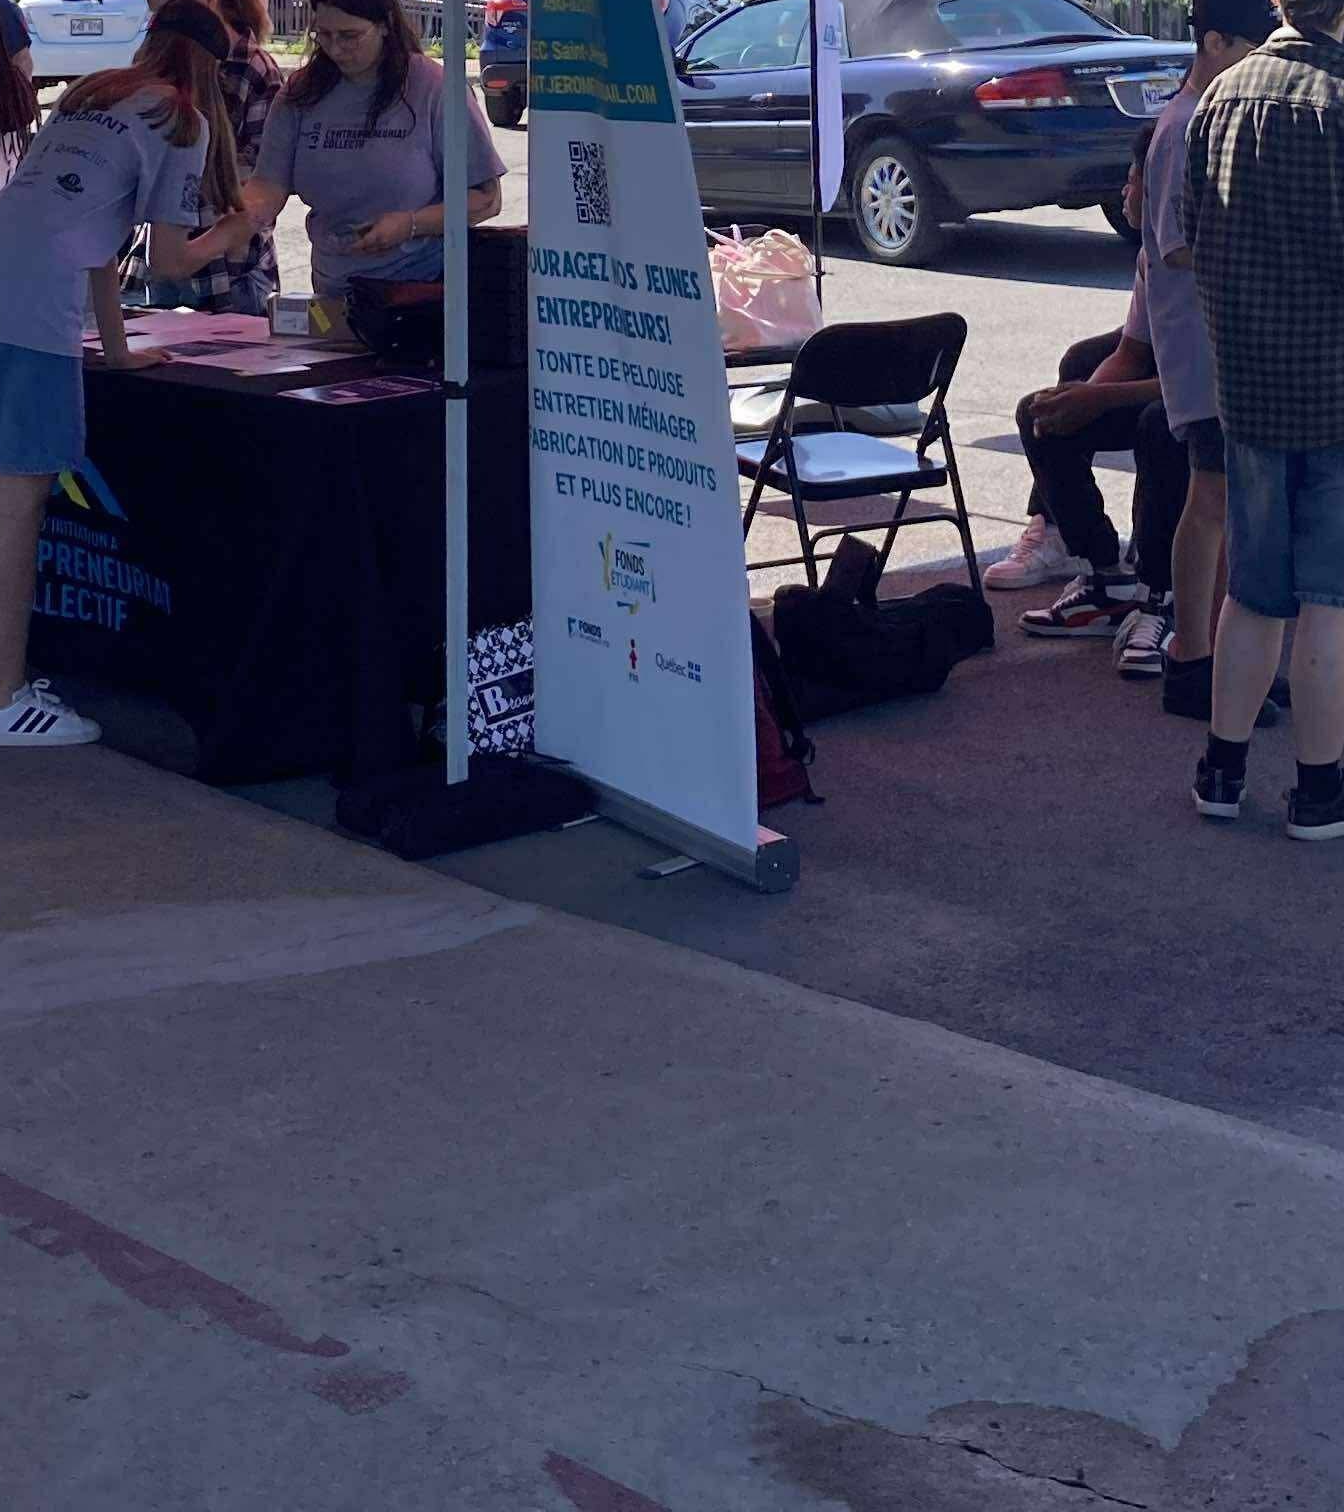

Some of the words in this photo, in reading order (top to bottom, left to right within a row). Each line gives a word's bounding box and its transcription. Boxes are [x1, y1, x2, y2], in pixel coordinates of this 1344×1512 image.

[645, 263, 702, 300] JEUNES
[536, 348, 594, 377] TONTE
[598, 356, 620, 381] DE
[621, 361, 685, 397] PELOUSE
[533, 388, 624, 426] ENTRETIEN
[627, 401, 698, 445] MÉNAGER
[626, 445, 646, 472] DE
[648, 450, 717, 492] PRODUITS
[555, 471, 577, 497] ET
[580, 476, 622, 508] PLUS
[625, 487, 685, 527] ENCORE
[615, 548, 645, 577] FONDS
